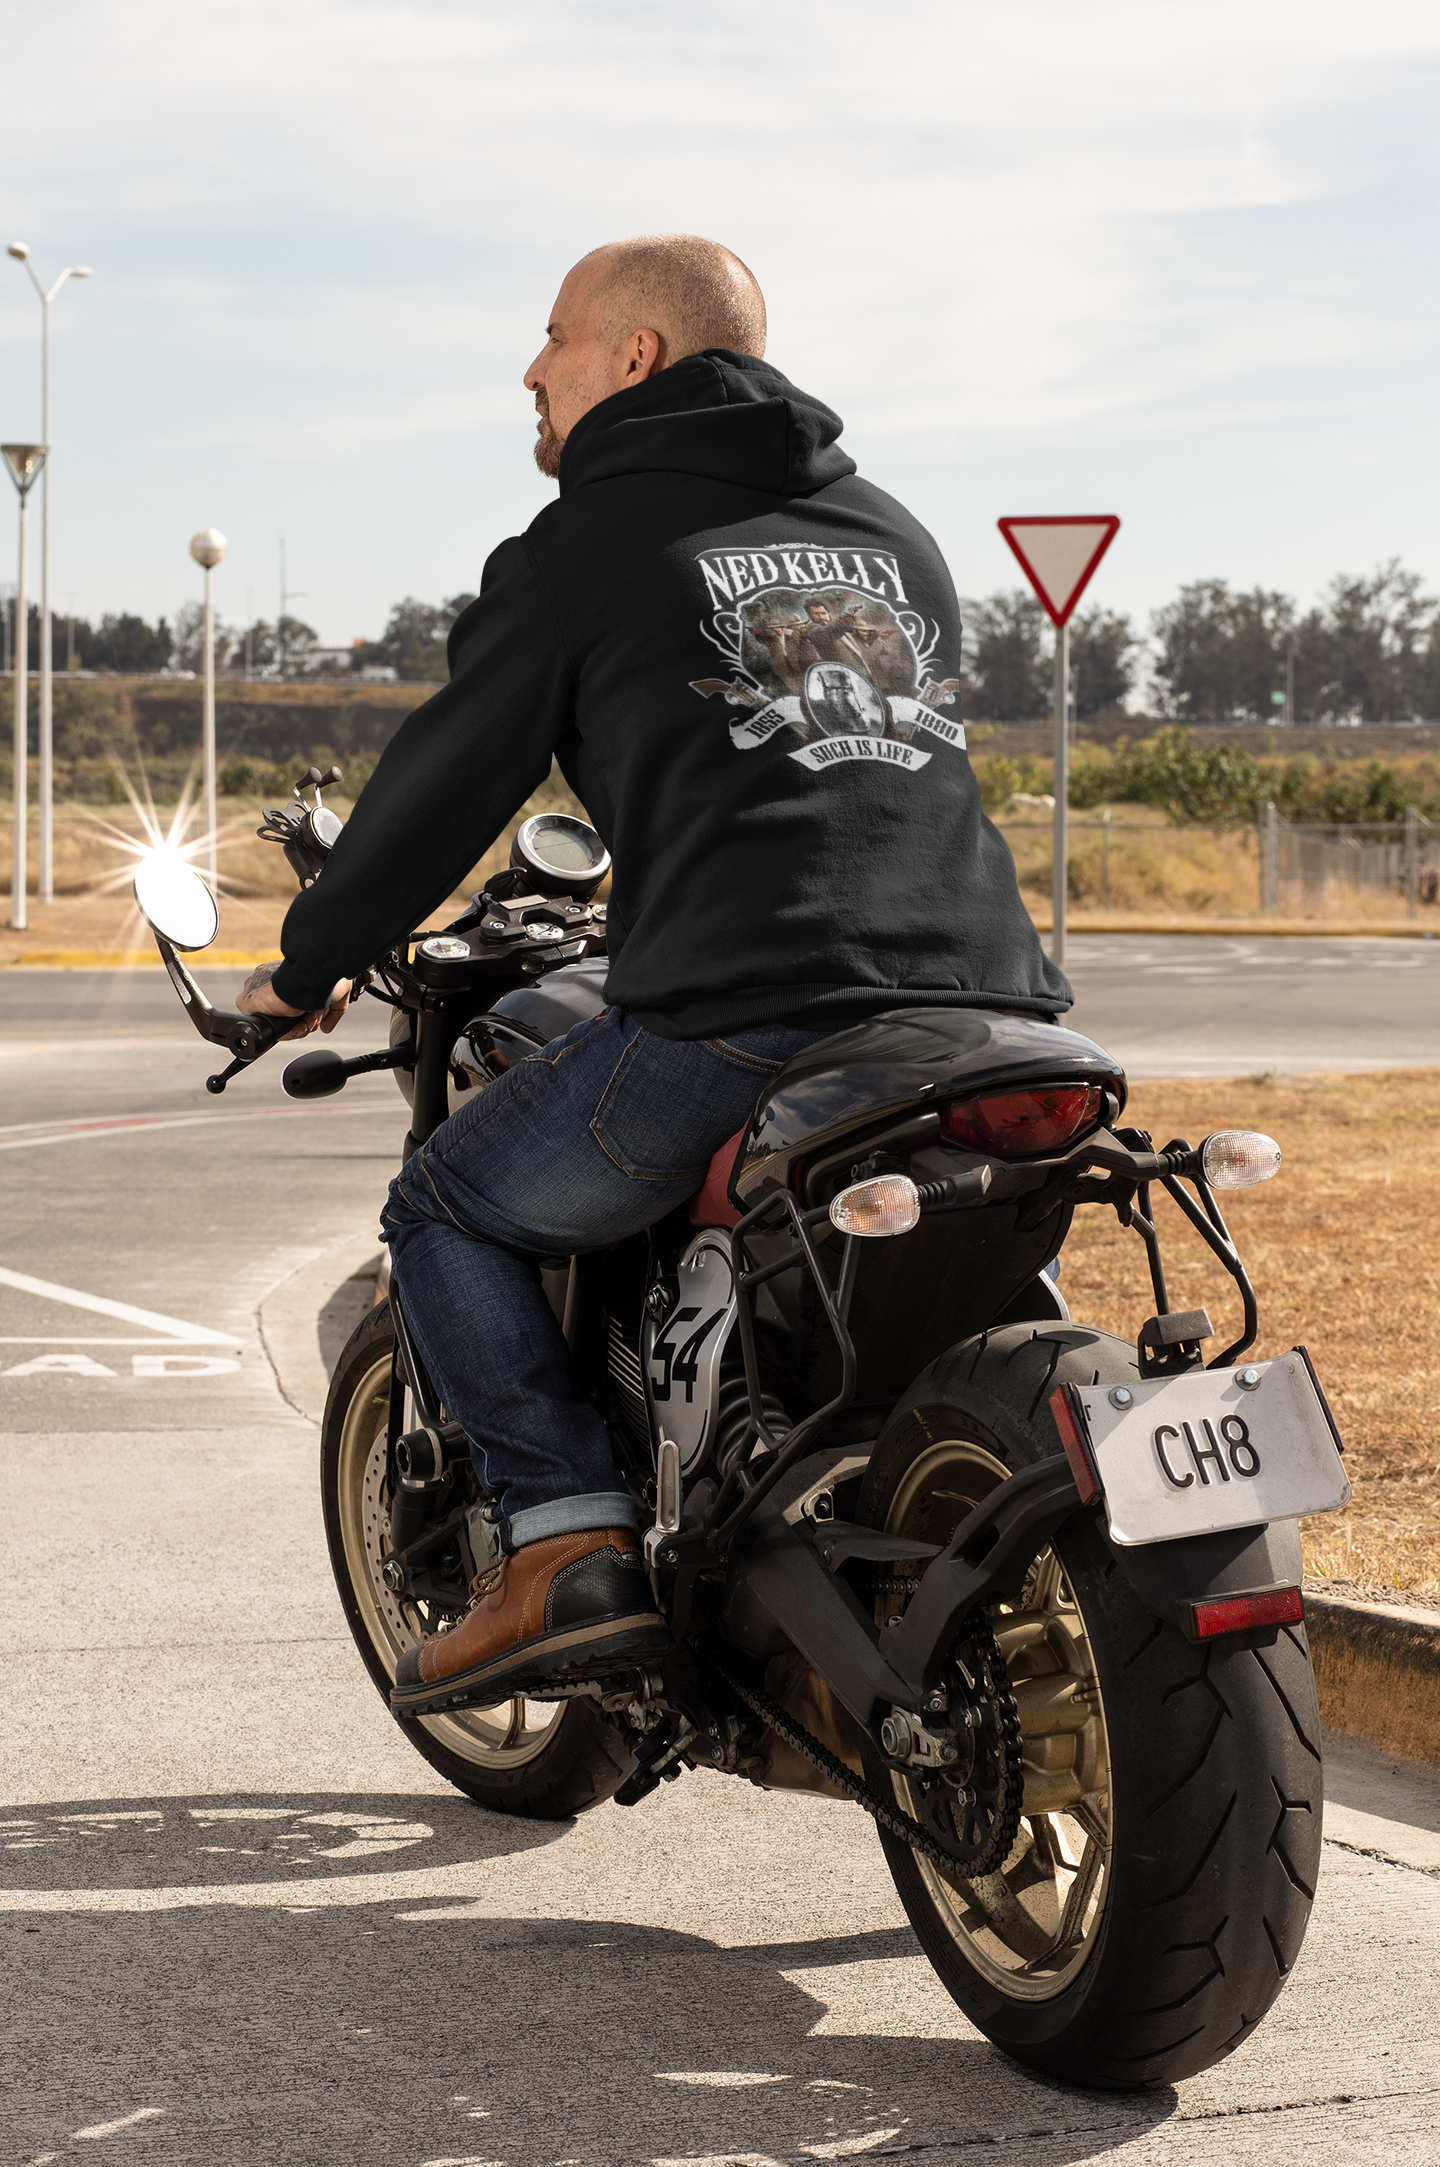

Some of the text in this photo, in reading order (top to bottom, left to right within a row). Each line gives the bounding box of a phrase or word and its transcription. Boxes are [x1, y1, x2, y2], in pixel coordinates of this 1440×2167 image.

[699, 551, 909, 611] NED KELLY
[744, 709, 786, 739] 1855
[914, 709, 959, 741] 1880
[809, 739, 913, 765] SUCH IS LIFE
[0, 1354, 242, 1377] AD
[651, 1306, 728, 1404] 54
[1154, 1414, 1261, 1488] CH8
